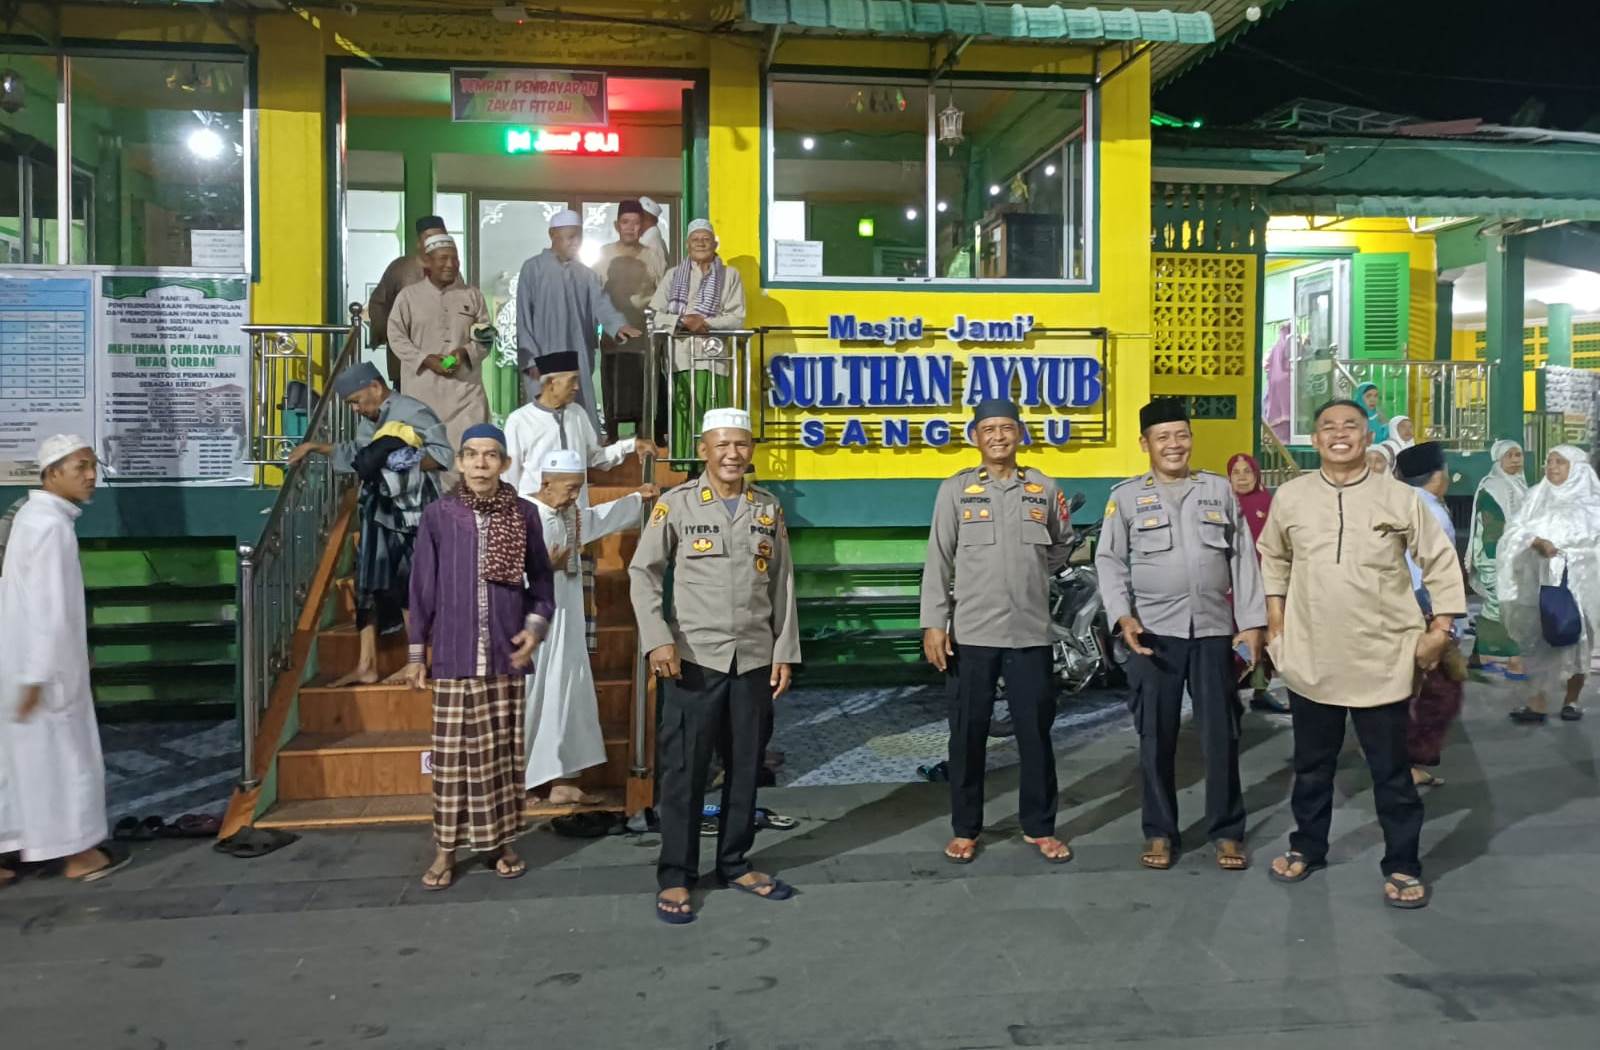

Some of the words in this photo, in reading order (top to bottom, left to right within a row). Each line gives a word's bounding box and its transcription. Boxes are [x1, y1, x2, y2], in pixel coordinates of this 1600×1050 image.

[460, 78, 511, 94] TEMPAT
[514, 79, 599, 97] PEMBAYARAN
[487, 99, 524, 113] ZAKAT
[529, 100, 572, 114] FITRAH
[828, 314, 923, 345] Masjid
[107, 344, 167, 355] MENERIMA
[170, 345, 241, 355] PEMBAYARAN
[135, 357, 167, 368] INFAQ
[170, 357, 215, 368] QURBAN
[768, 354, 953, 409] SULTHAN
[965, 355, 1104, 408] AYYUB
[801, 418, 1072, 447] SANGU
